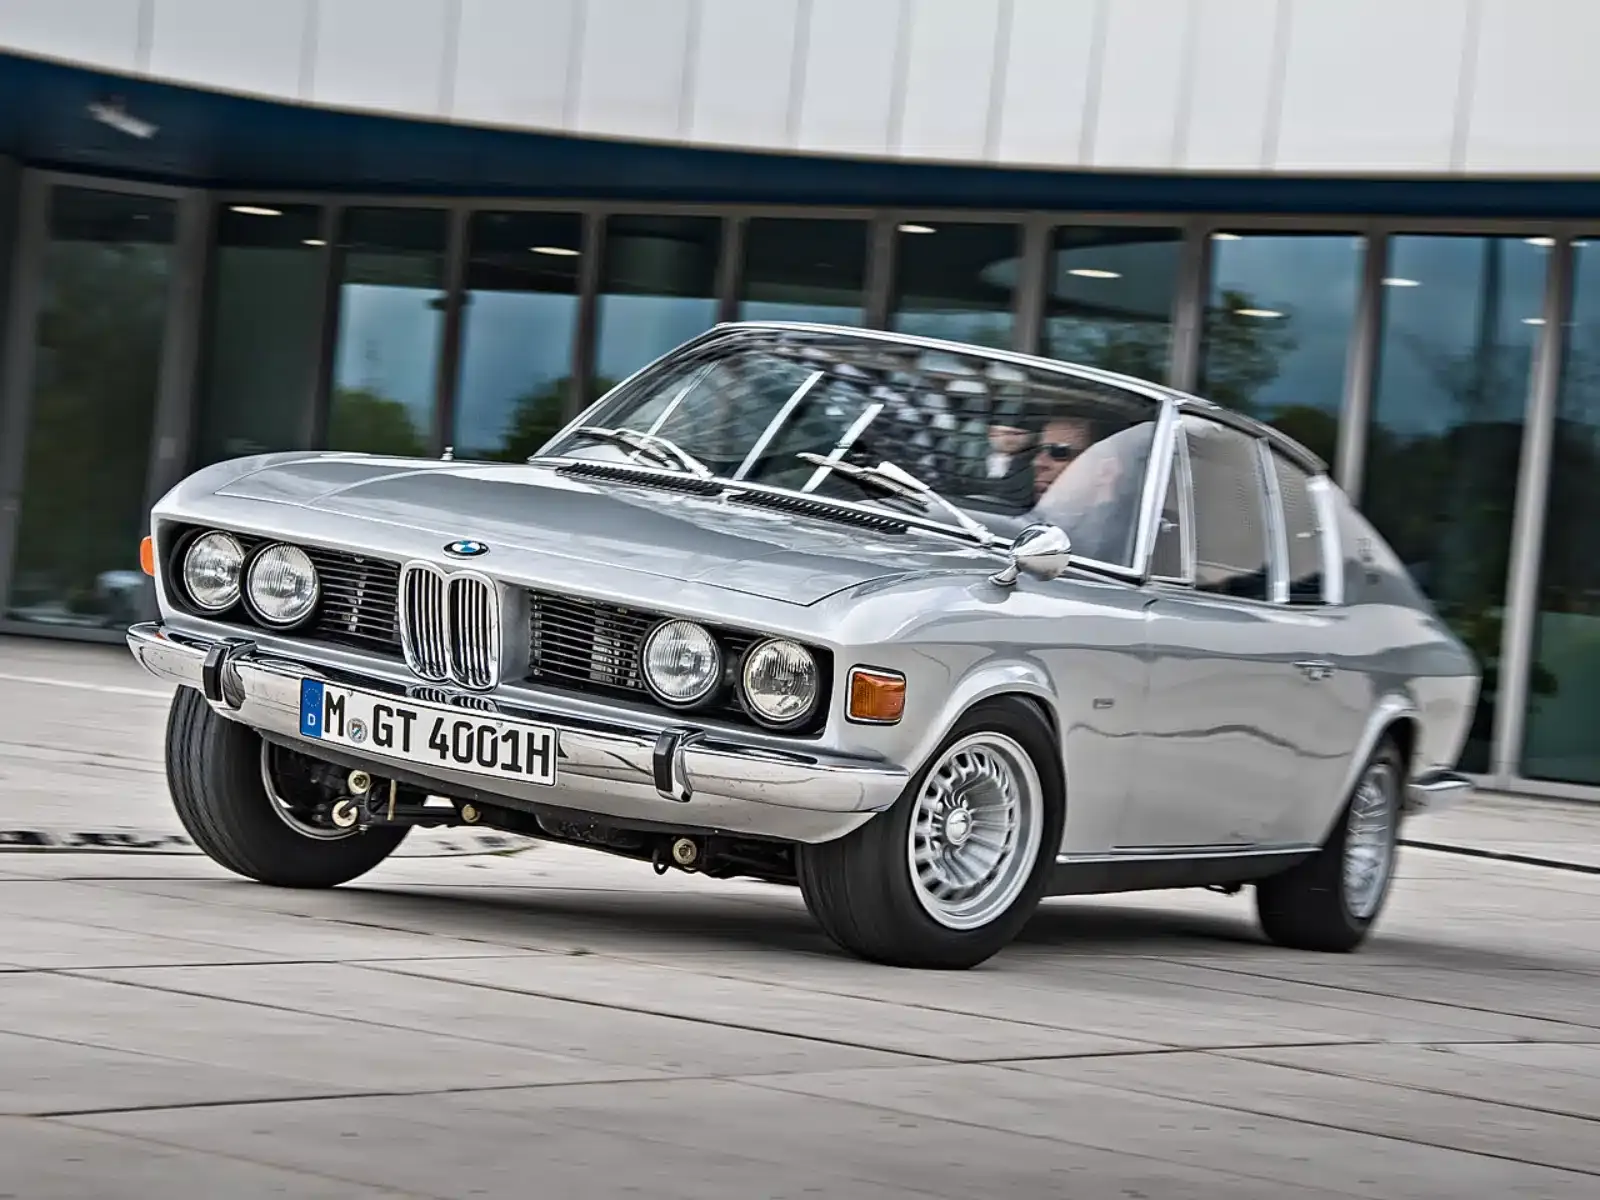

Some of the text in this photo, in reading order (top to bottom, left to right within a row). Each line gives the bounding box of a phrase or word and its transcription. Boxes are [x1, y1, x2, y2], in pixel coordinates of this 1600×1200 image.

[307, 713, 316, 726] D
[324, 691, 345, 736] M
[372, 704, 417, 752] GT
[428, 717, 550, 777] 4001H
